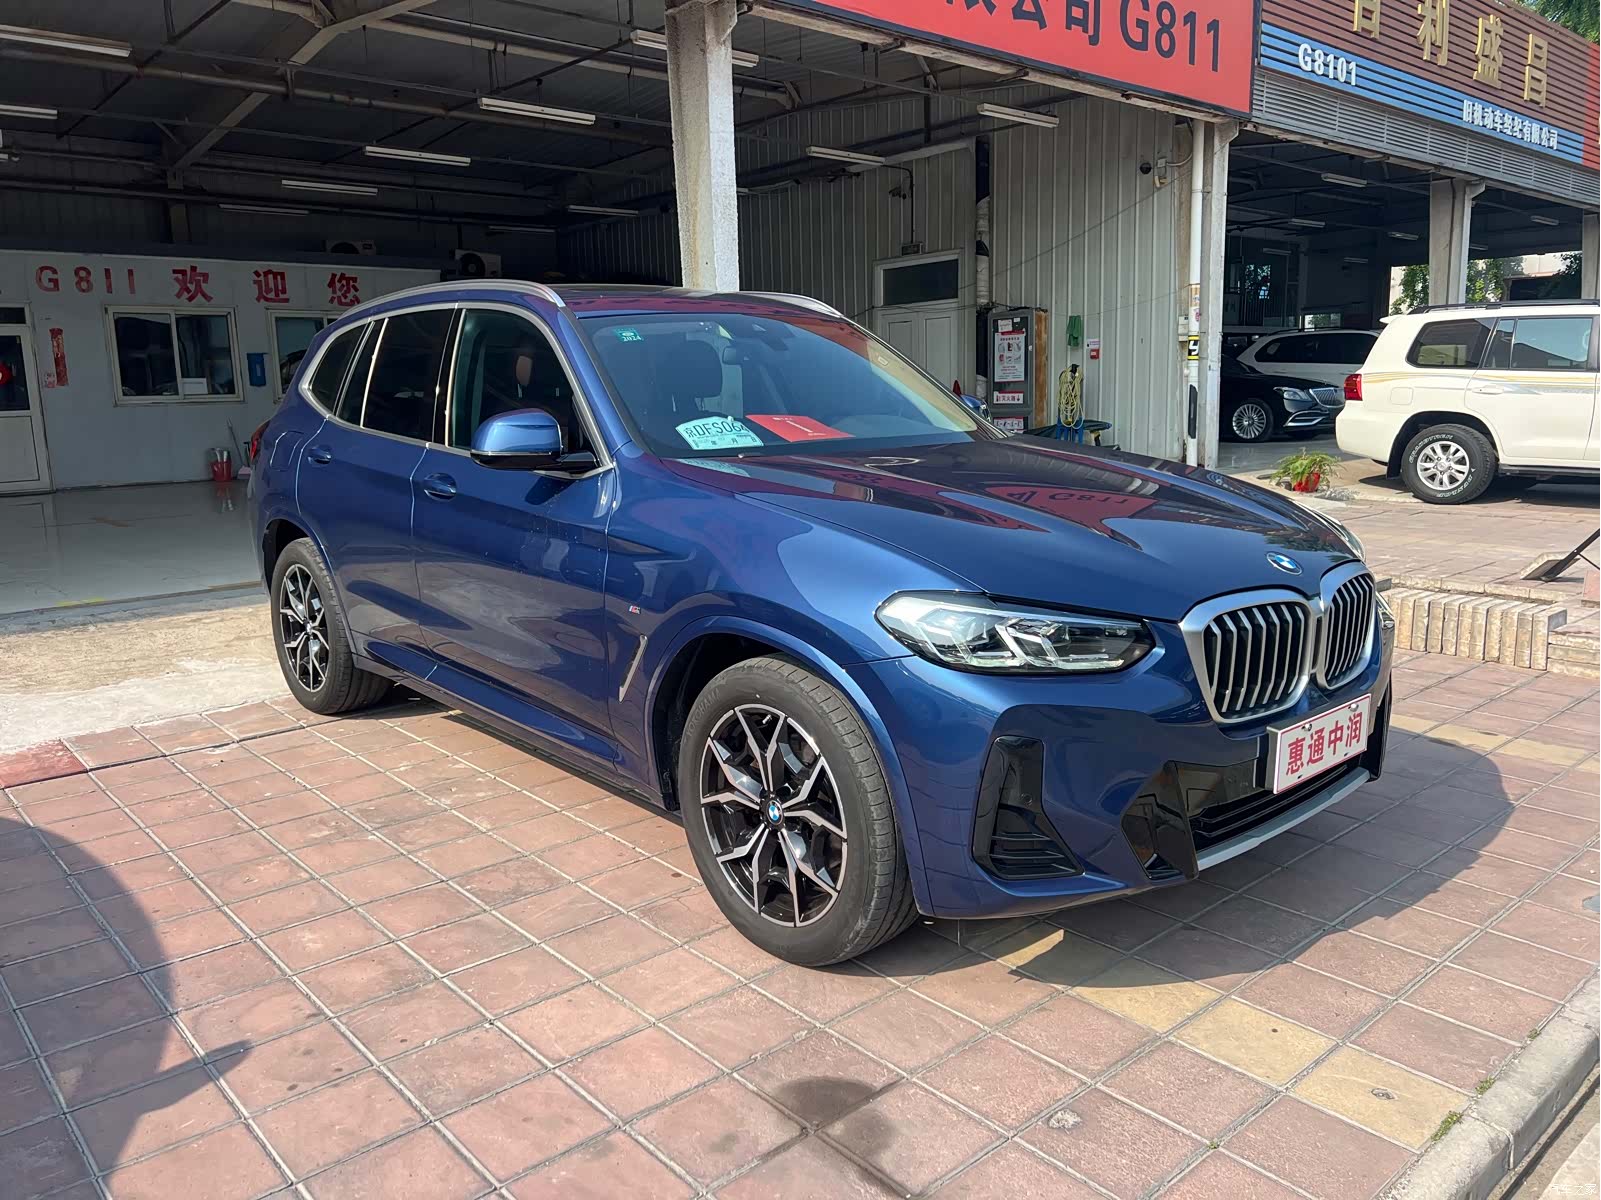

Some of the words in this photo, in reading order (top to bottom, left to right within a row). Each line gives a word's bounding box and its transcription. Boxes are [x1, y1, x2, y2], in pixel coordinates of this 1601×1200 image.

[946, 0, 1100, 46] 公司
[1119, 0, 1220, 72] G811
[1298, 43, 1357, 86] G8101
[1463, 99, 1558, 150] 旧机动车经纪有限公司
[35, 265, 137, 294] G811
[172, 265, 361, 307] 欢迎您
[1286, 712, 1363, 776] 惠通中润
